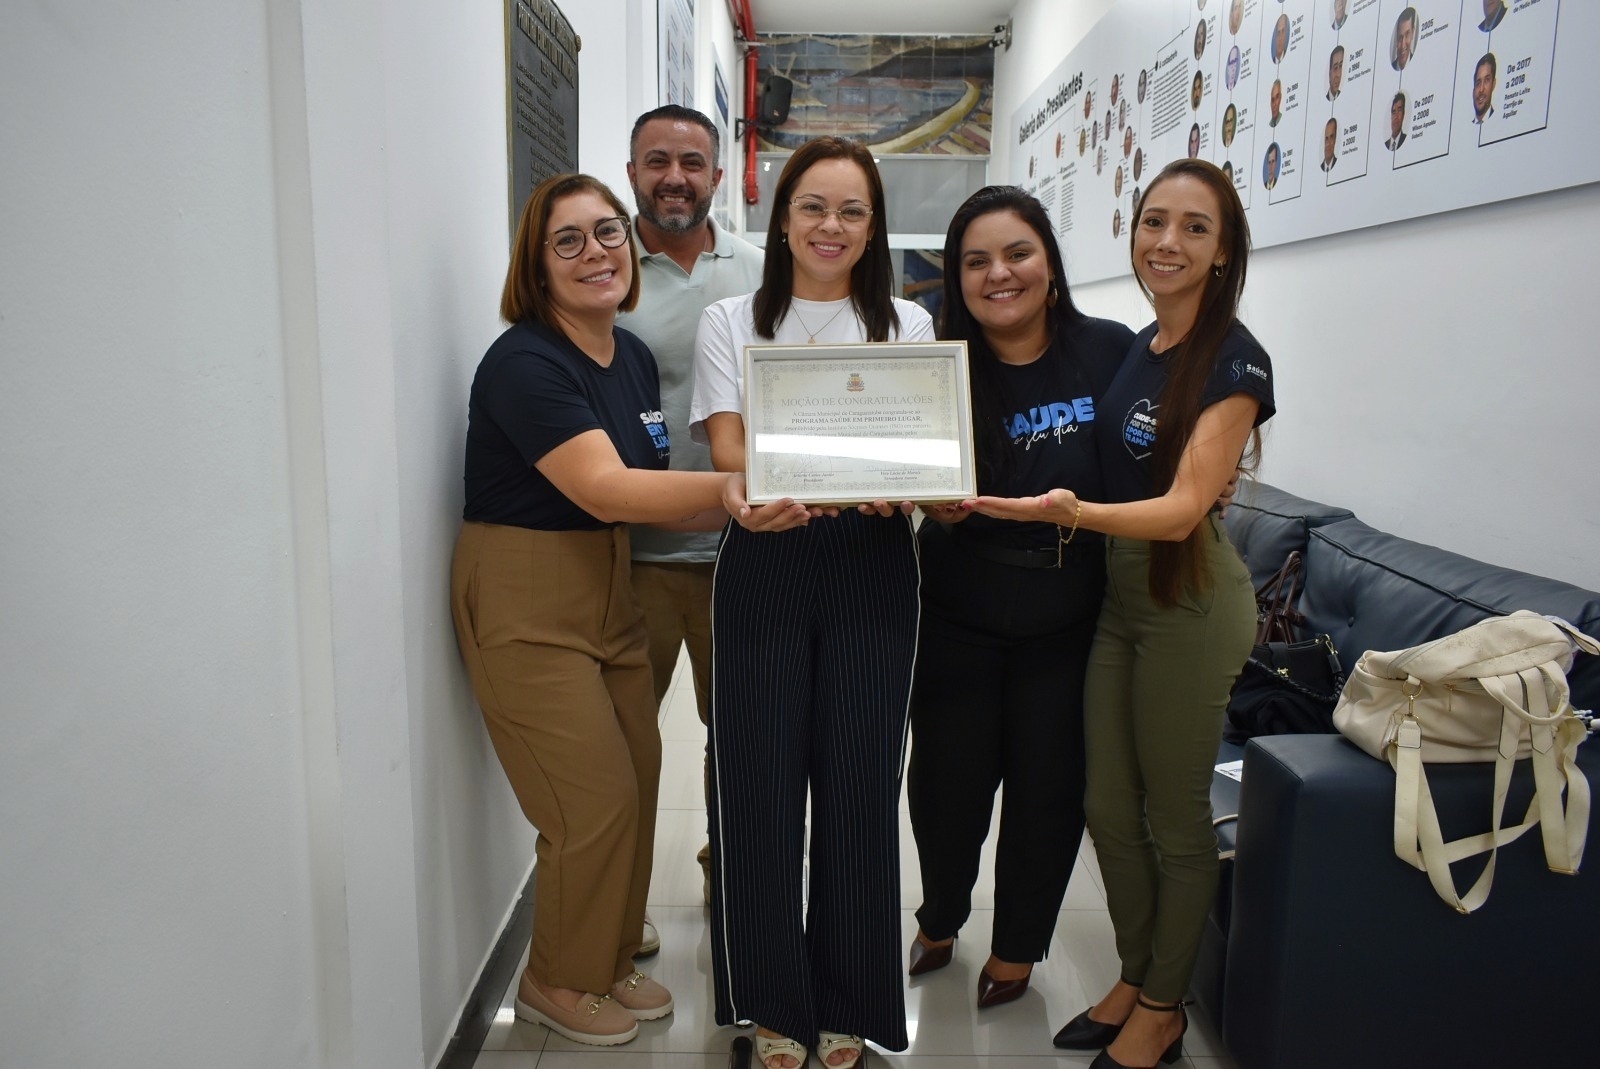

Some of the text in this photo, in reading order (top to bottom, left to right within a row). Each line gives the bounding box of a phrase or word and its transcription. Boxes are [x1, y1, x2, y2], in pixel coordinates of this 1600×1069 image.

[1421, 18, 1434, 32] 2005
[1507, 57, 1532, 74] De 2017
[1506, 74, 1526, 89] a 2018
[1019, 113, 1035, 145] Galeria
[1036, 108, 1046, 130] dos
[1046, 71, 1083, 121] Presidentes
[1414, 94, 1434, 109] De 2007
[1417, 108, 1430, 120] 2008
[1246, 364, 1268, 378] Saúde
[782, 393, 934, 408] MOÇÃO DE CONGRATULAÇÕES
[640, 410, 664, 424] SAÚD
[1054, 416, 1078, 444] dia
[1141, 422, 1157, 434] VOC
[1143, 432, 1156, 441] QU
